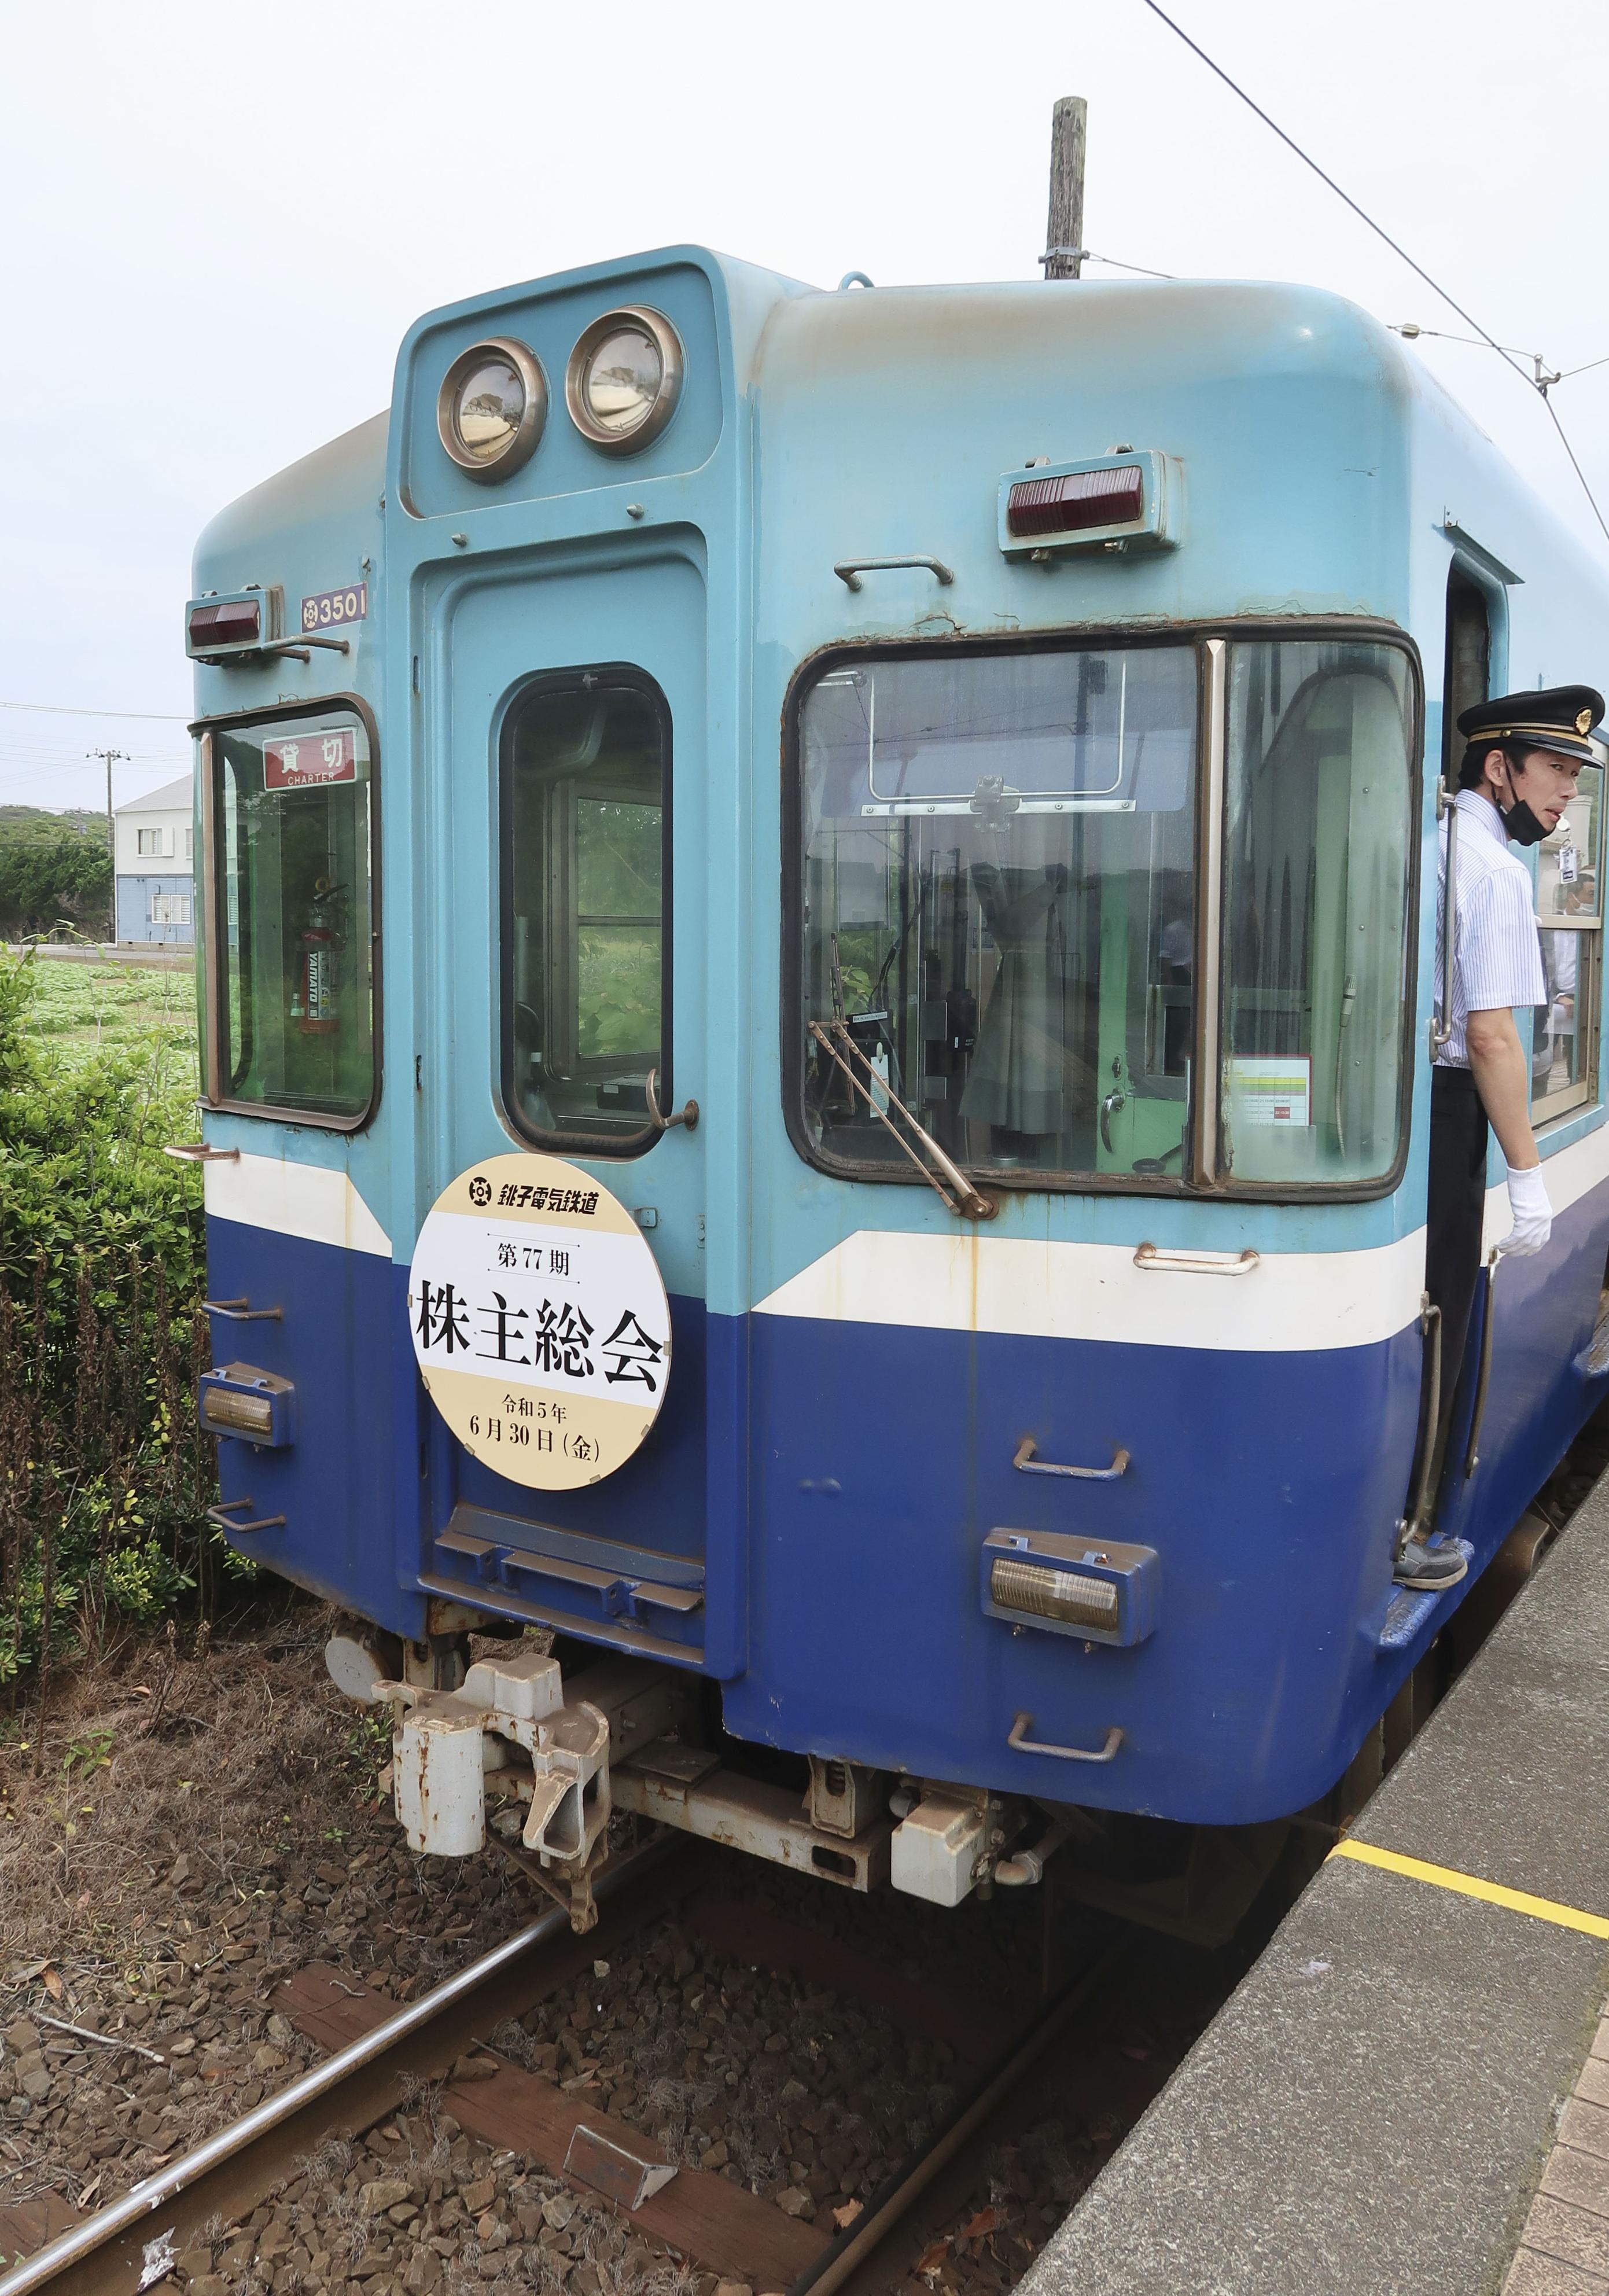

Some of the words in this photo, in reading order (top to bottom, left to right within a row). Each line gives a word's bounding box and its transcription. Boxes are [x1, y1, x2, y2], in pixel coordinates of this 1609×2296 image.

[320, 590, 365, 623] 3501
[288, 772, 334, 785] CHARTER
[310, 952, 318, 1003] YAMATO
[498, 1184, 599, 1215] 銚子電気鉄道
[415, 1279, 664, 1392] 株主総会
[501, 1393, 567, 1424] 令和5年
